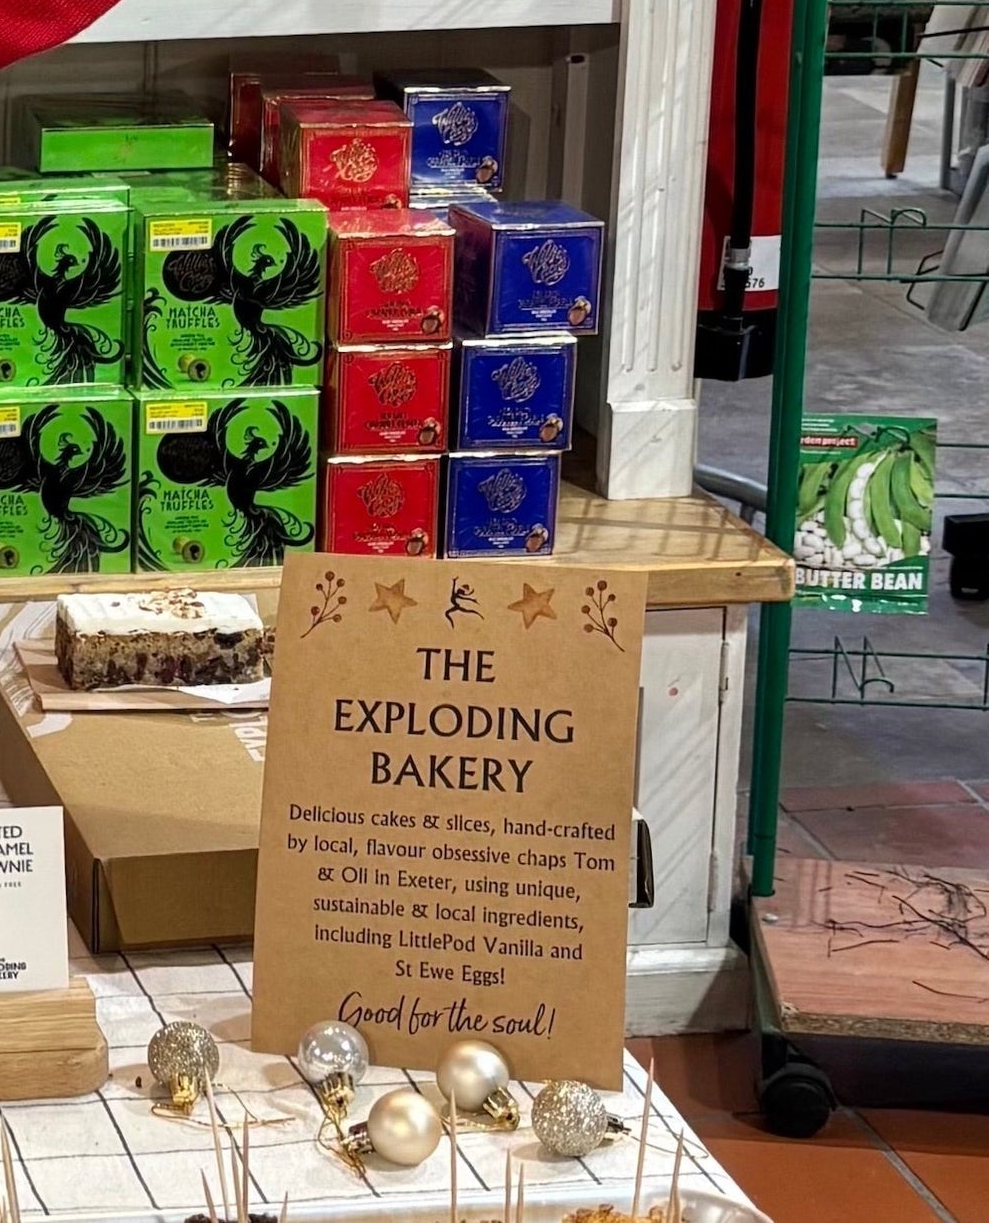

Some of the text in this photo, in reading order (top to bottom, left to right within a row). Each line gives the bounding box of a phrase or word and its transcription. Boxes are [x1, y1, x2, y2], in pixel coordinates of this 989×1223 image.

[166, 317, 220, 328] TRUFFLES
[169, 305, 216, 318] MATCHA
[161, 500, 214, 512] TRUFFLES
[163, 487, 210, 500] MATCHA
[796, 568, 923, 590] BUTTER BEAN
[417, 648, 496, 683] THE
[334, 699, 574, 744] EXPLODING
[371, 751, 533, 793] BAKERY
[290, 804, 615, 841] Delicious cakes & slices, hand-crafted
[287, 833, 615, 872] by local, flavour obsessive chaps Tom
[317, 866, 581, 903] & Oli in Exeter, using unique,
[313, 897, 584, 934] sustainable & local ingredients,
[315, 924, 583, 960] including LittlePod Vanilla and
[395, 960, 506, 987] St Ewe Eggs!
[338, 991, 556, 1040] Good for the soul!
